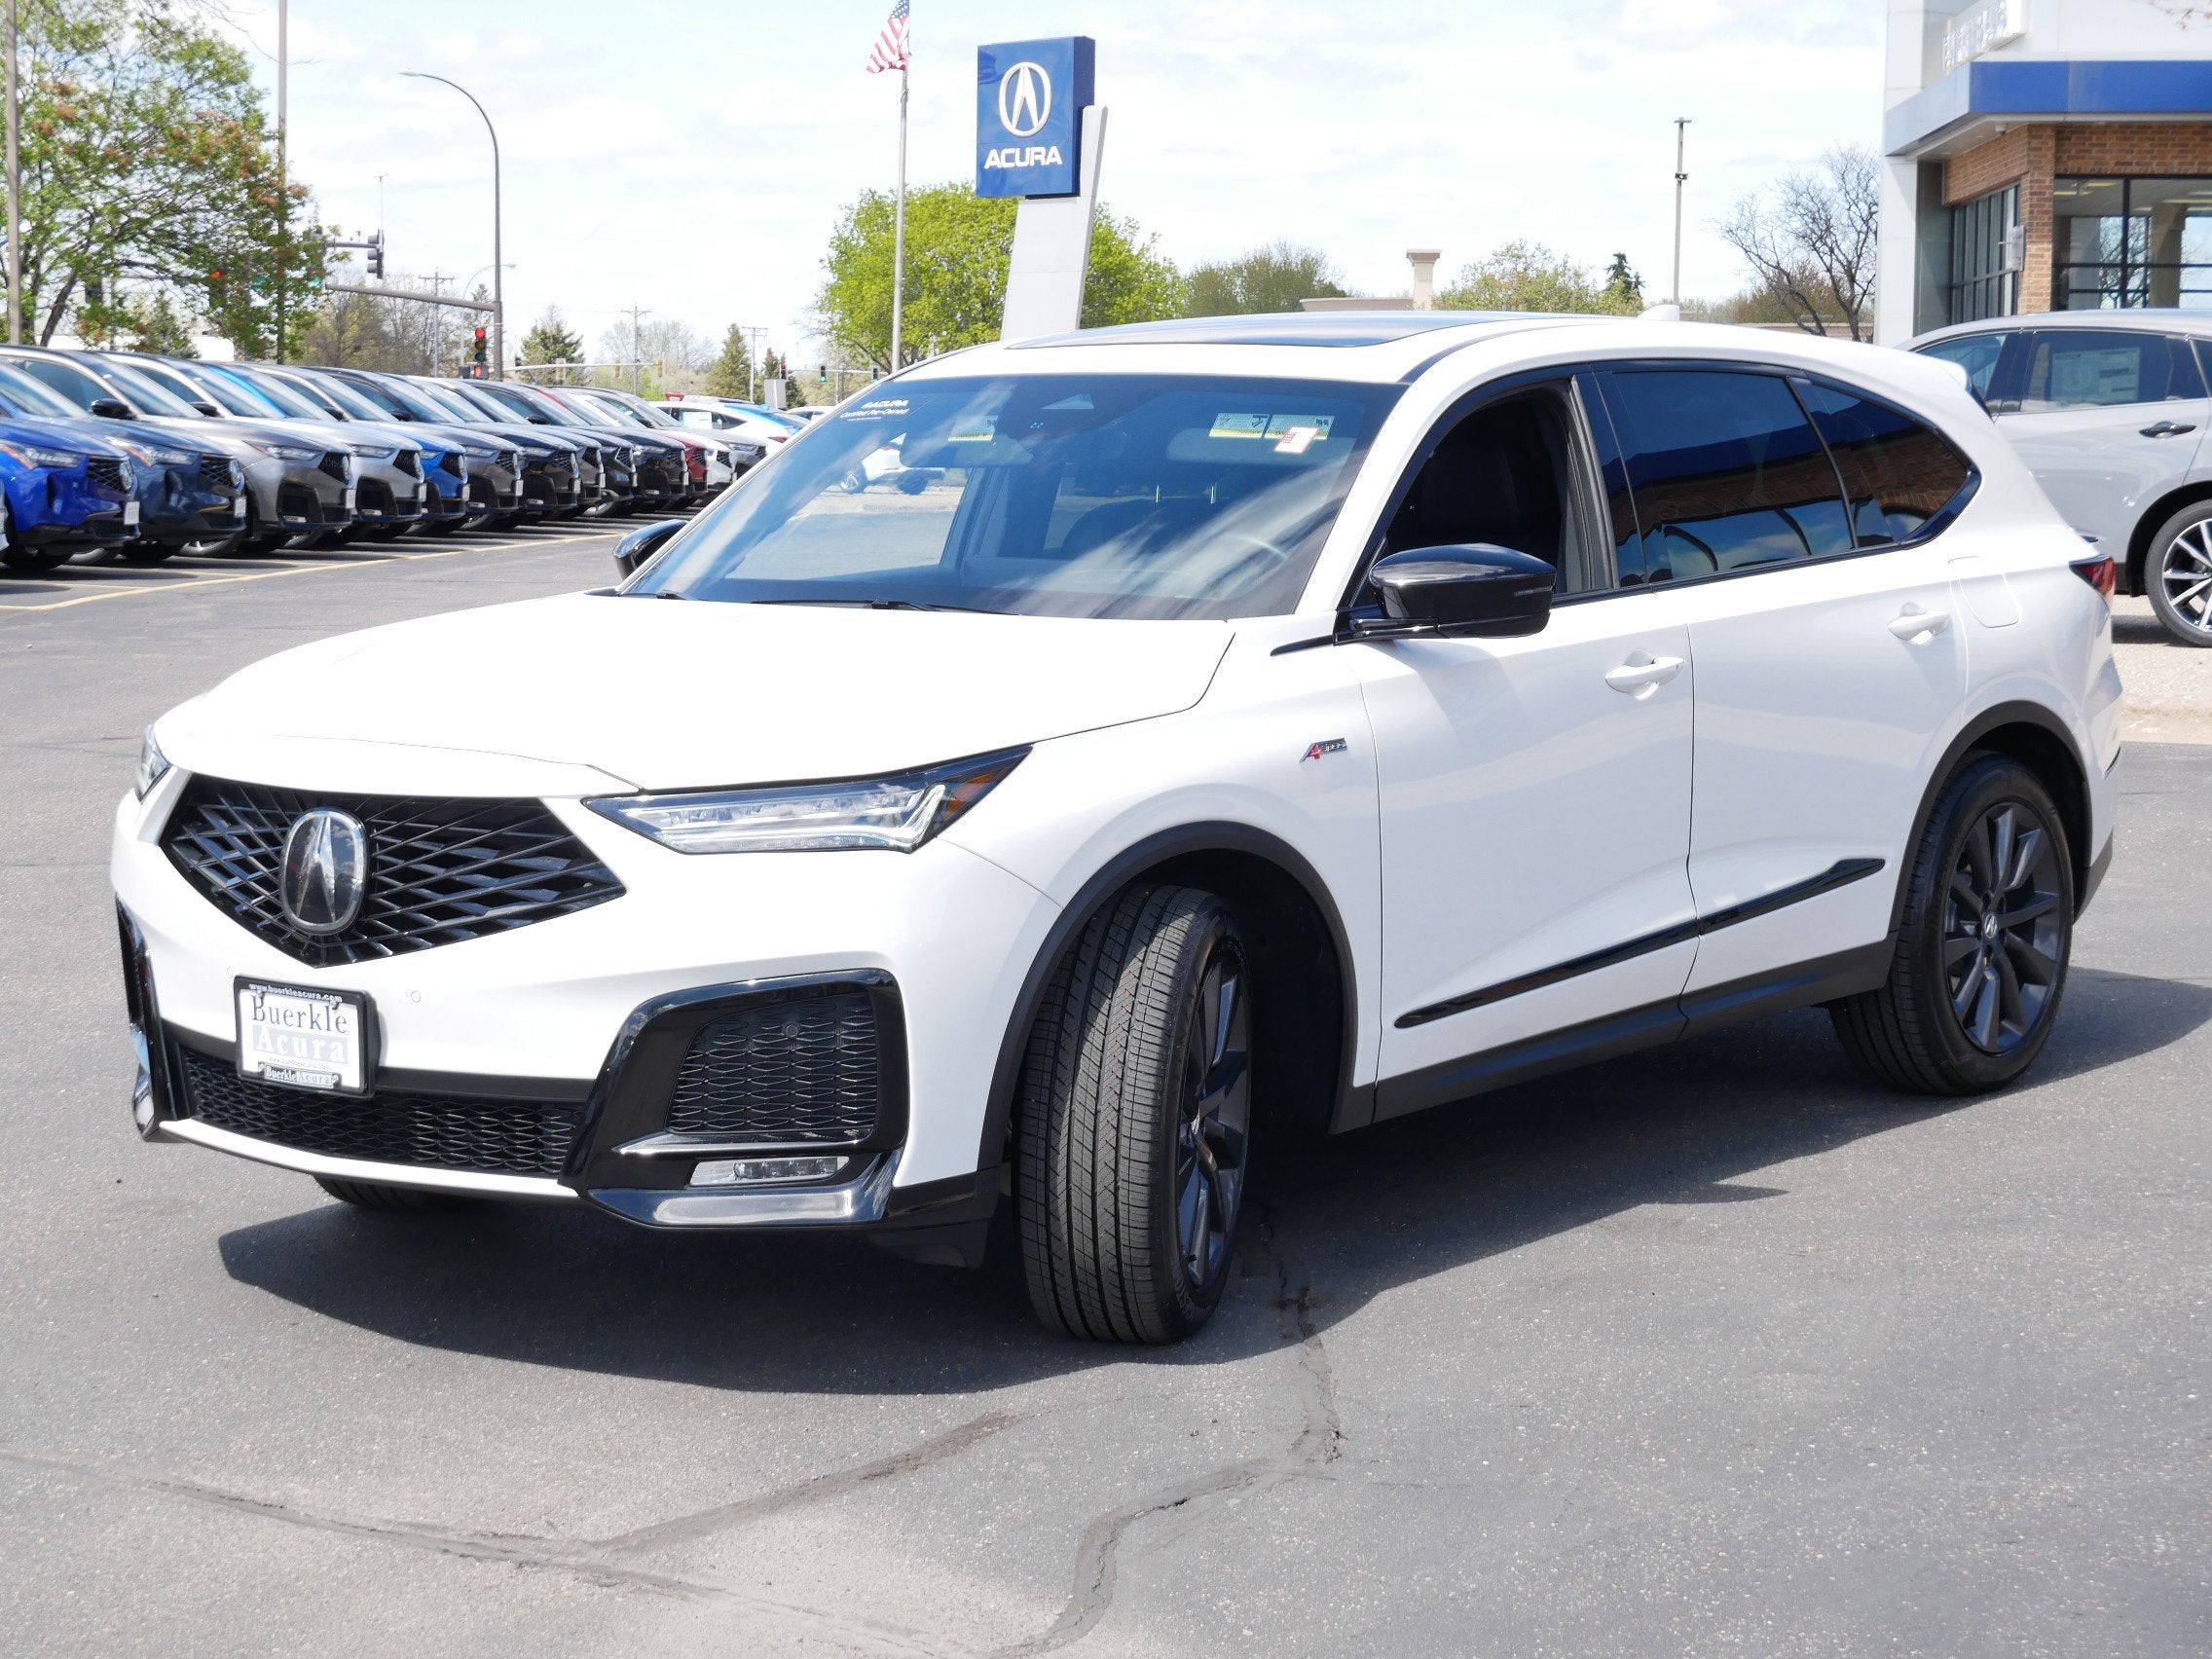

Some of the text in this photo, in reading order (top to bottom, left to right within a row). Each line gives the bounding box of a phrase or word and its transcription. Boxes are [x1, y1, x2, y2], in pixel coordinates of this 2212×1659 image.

[983, 145, 1063, 169] ACURA
[249, 983, 343, 1002] www.buerkleacura.com
[252, 995, 347, 1033] Buerkle
[257, 1027, 345, 1062] Acura
[266, 1065, 331, 1085] Buerkle Acura
